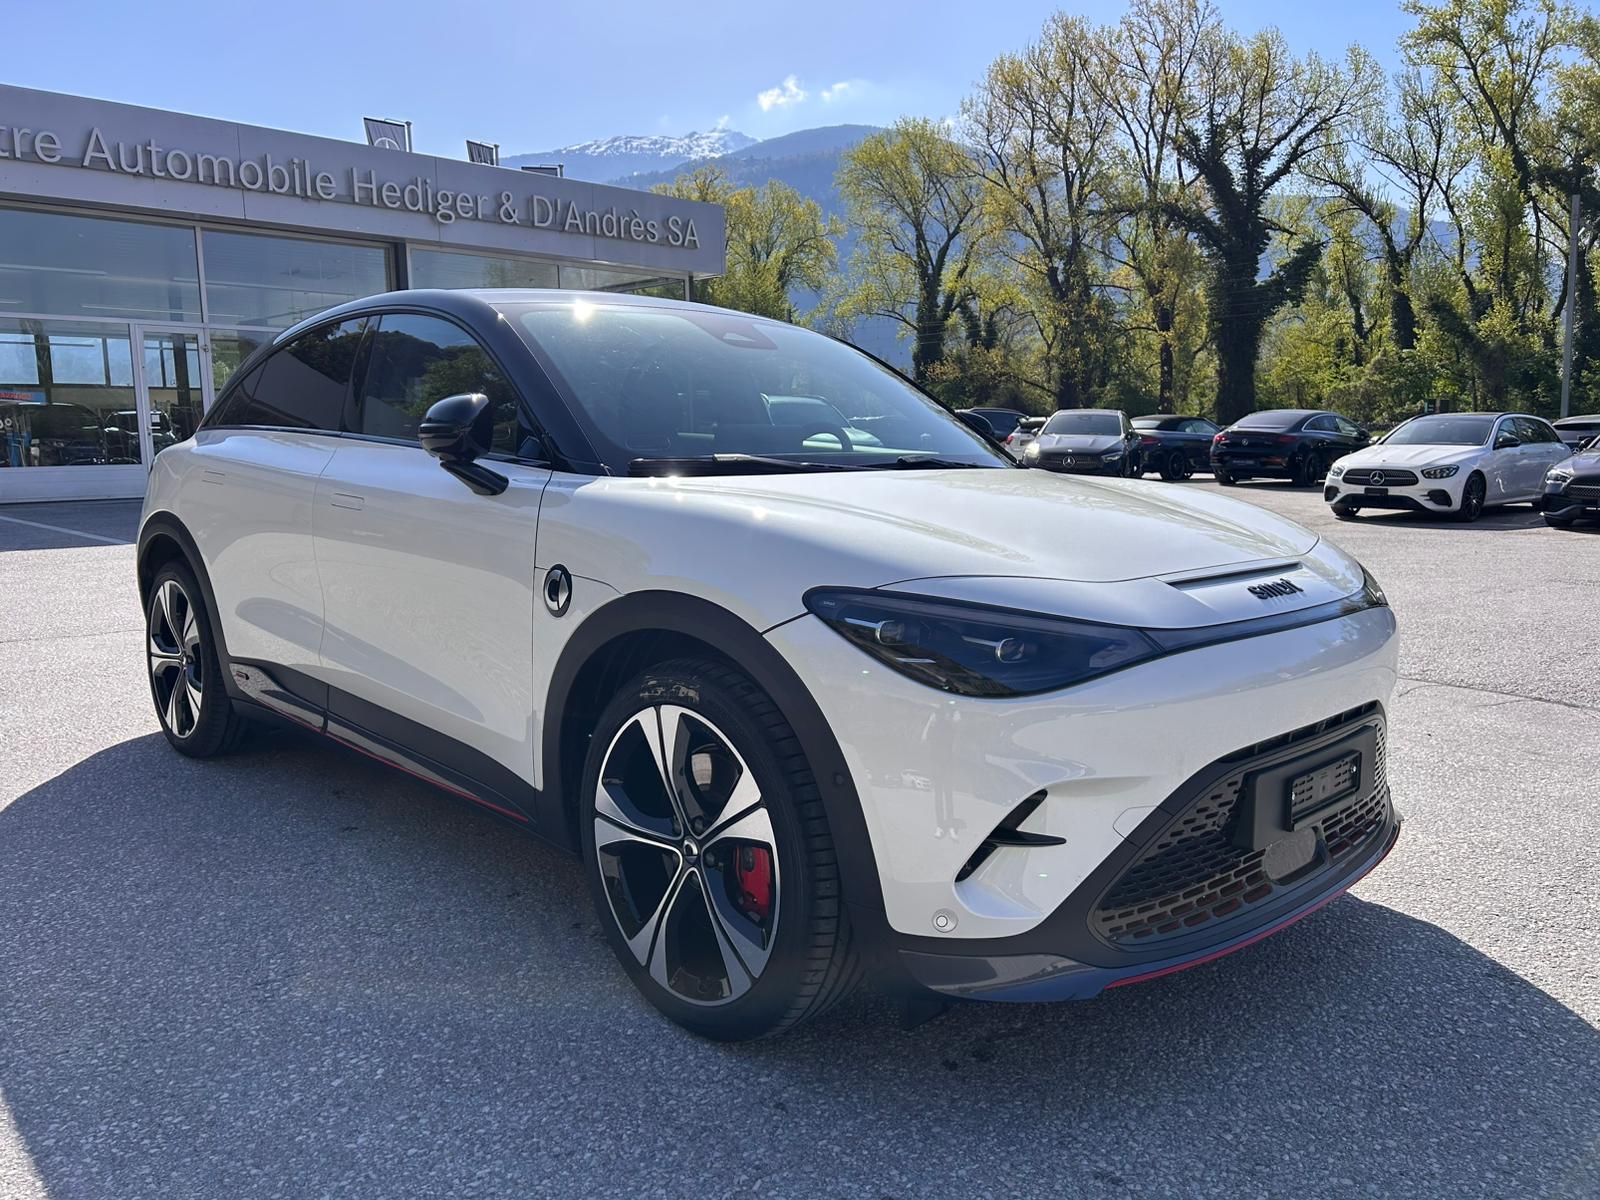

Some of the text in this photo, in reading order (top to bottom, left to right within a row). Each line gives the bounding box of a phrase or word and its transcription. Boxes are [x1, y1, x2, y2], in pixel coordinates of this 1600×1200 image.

[82, 127, 337, 199] Automobile
[351, 167, 488, 224] Hediger
[499, 191, 520, 225] &
[532, 195, 658, 243] D'Andrès
[667, 215, 700, 249] SA
